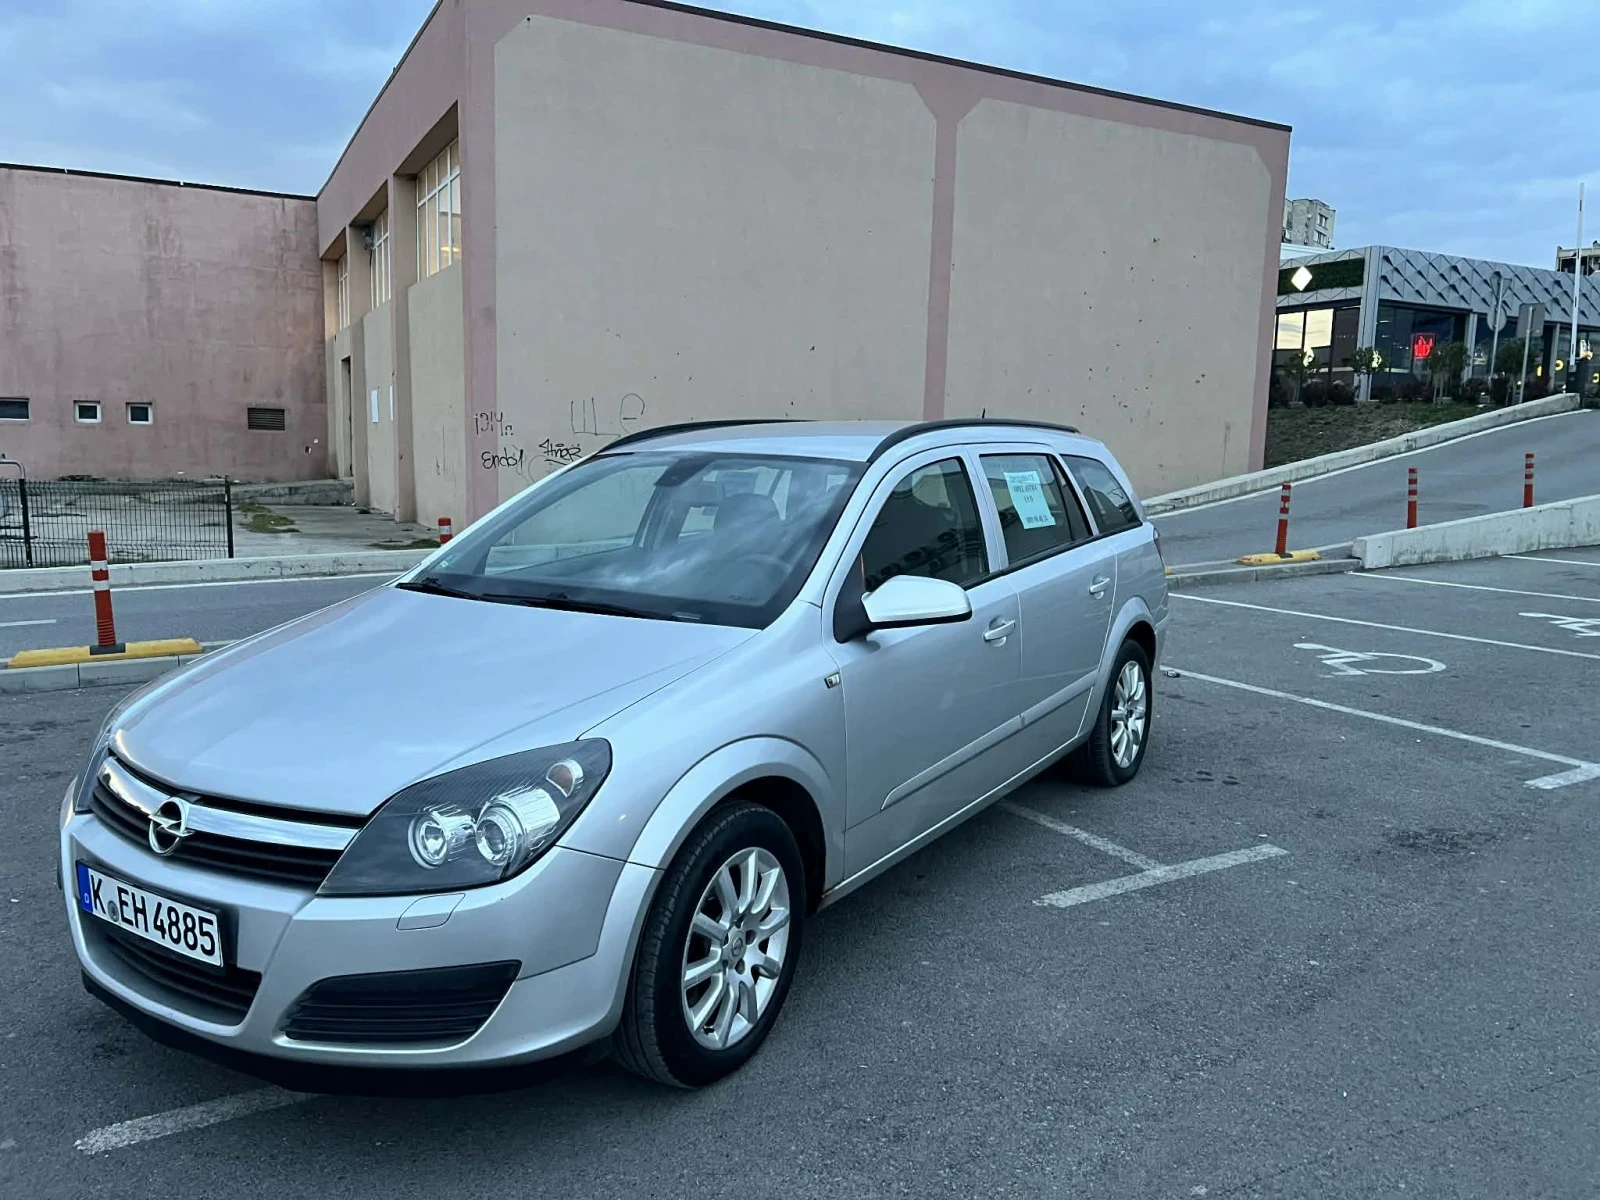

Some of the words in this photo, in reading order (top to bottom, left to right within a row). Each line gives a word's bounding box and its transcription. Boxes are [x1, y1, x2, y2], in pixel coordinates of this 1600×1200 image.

[90, 874, 107, 915] K
[117, 885, 149, 933] EH
[153, 901, 216, 957] 4885
